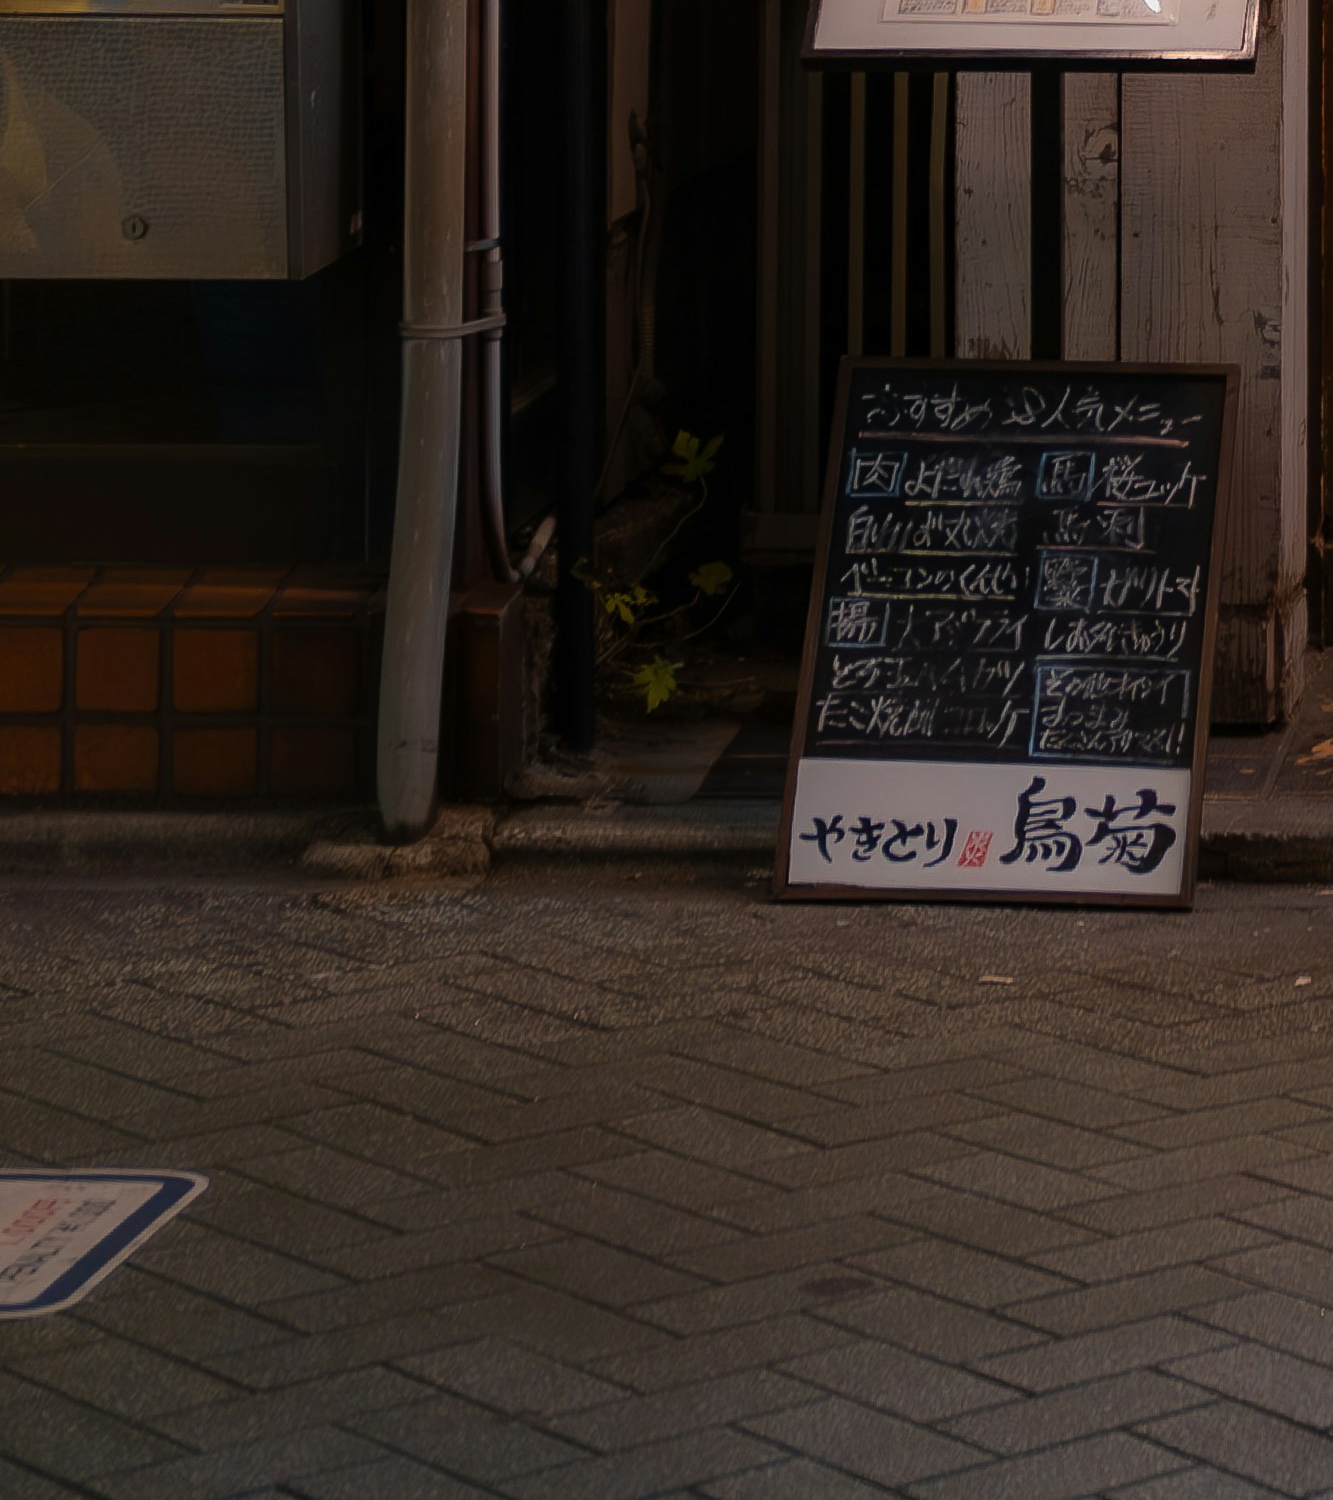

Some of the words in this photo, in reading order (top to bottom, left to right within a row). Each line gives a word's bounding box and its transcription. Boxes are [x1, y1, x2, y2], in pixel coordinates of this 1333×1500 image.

[799, 814, 960, 869] やきとり
[1000, 775, 1179, 873] 鳥菊
